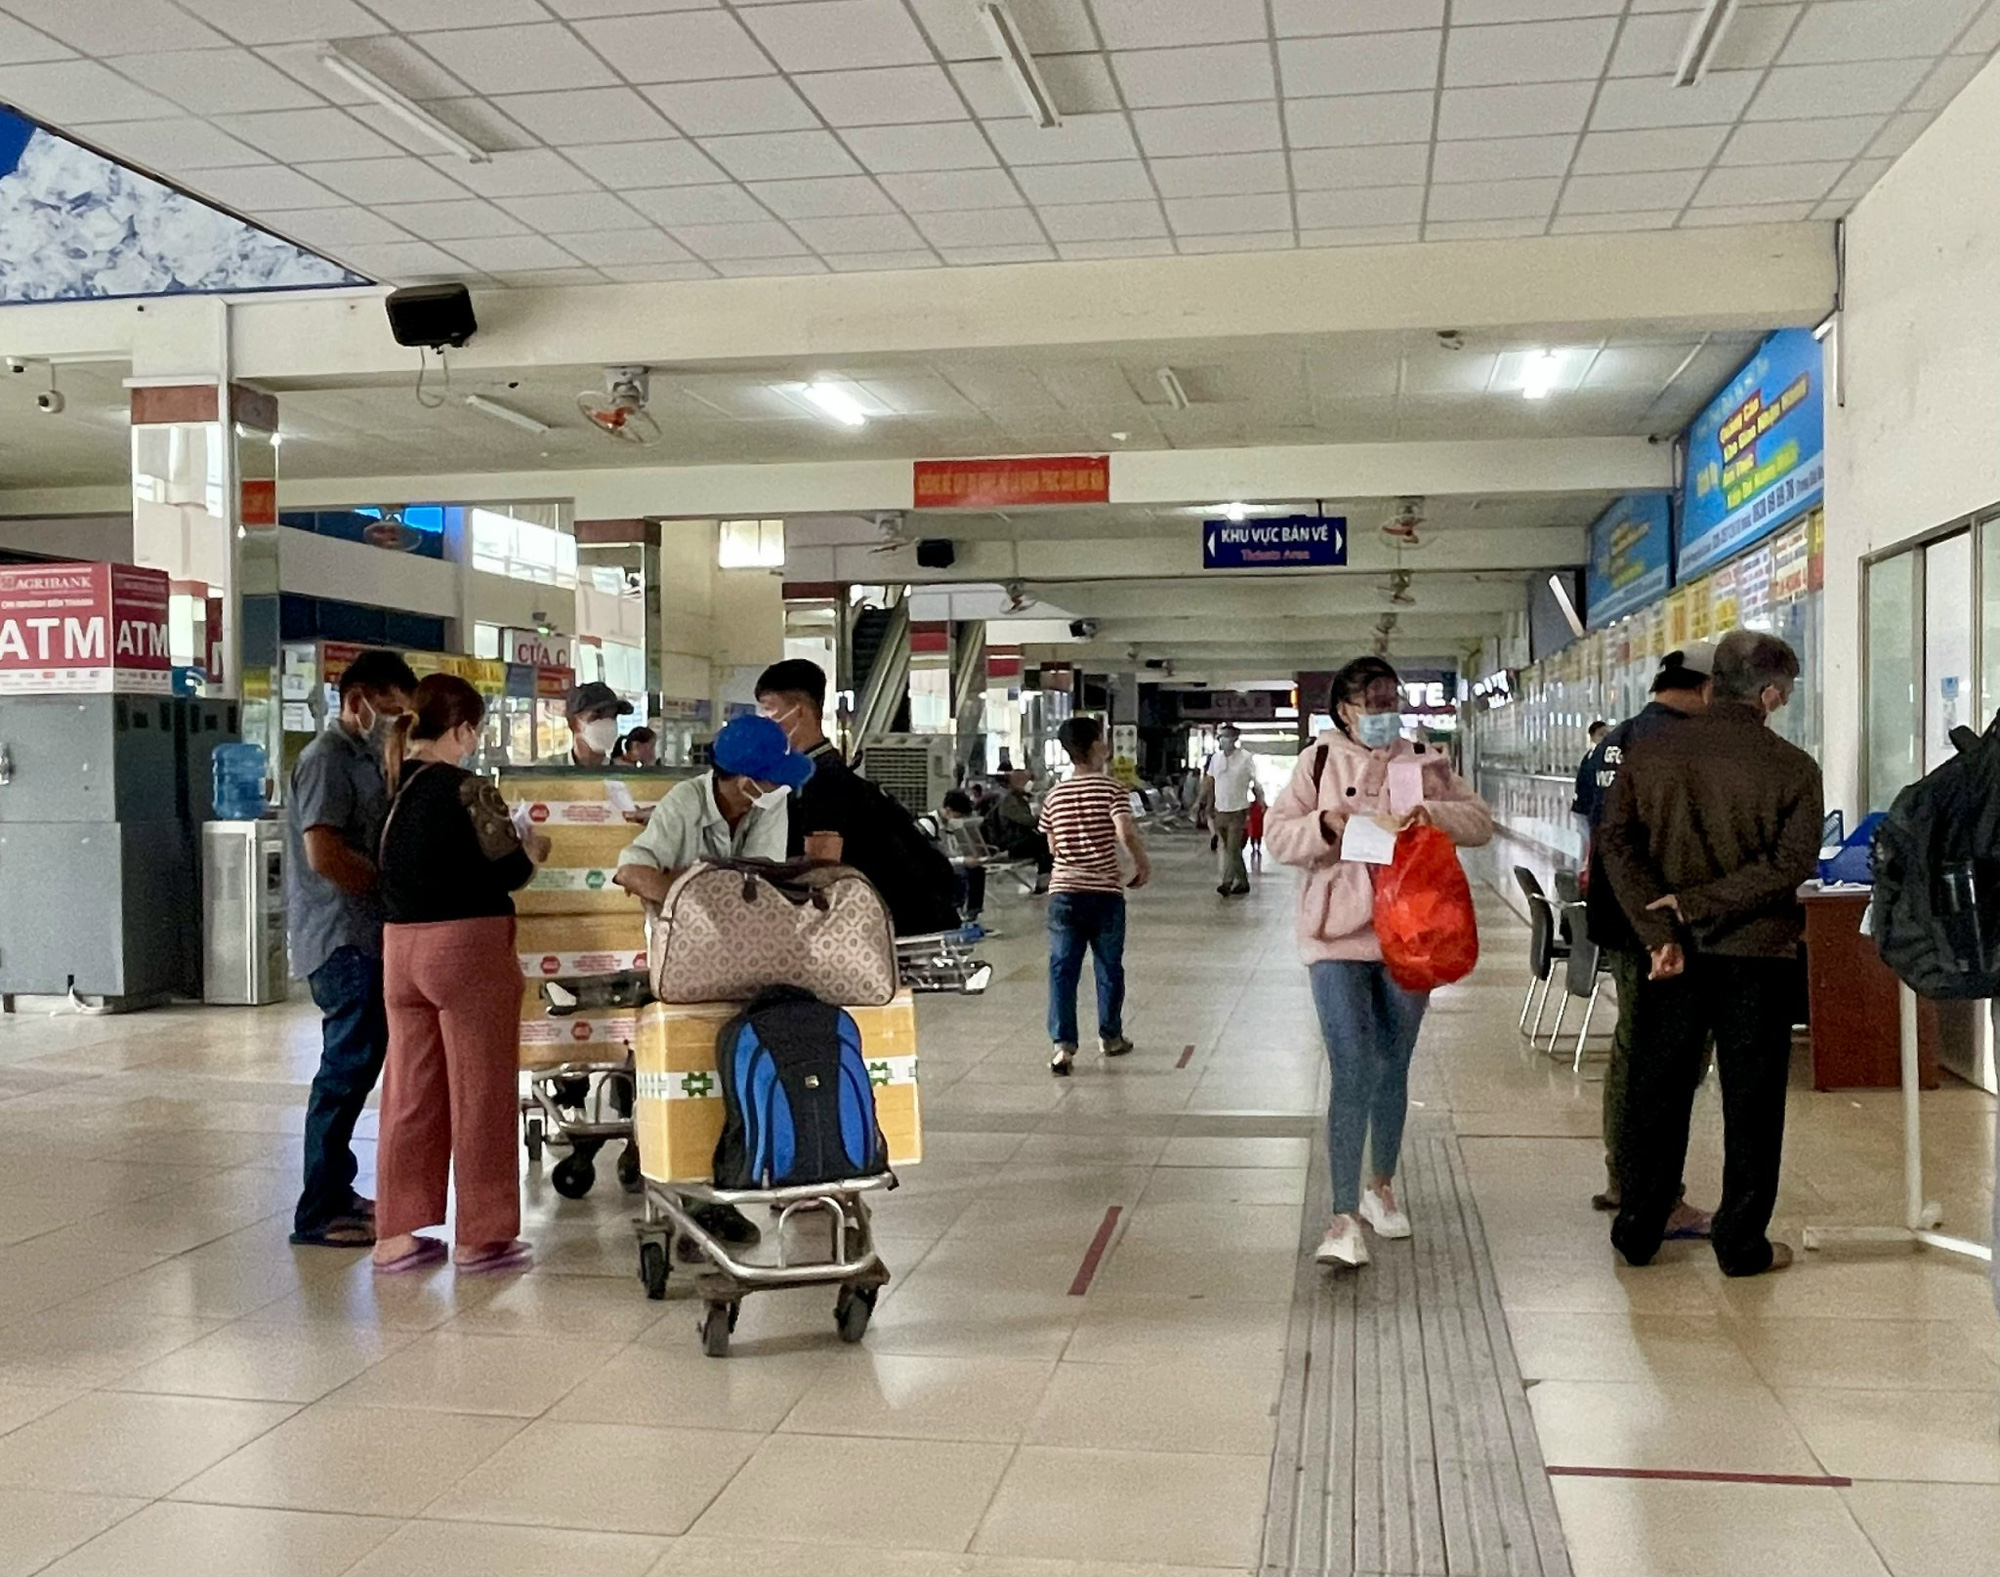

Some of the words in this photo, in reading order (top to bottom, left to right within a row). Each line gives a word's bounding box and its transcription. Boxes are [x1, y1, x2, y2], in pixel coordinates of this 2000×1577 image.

[1221, 528, 1249, 543] KHU
[1251, 527, 1280, 545] VỰC
[1281, 524, 1310, 542] BÁN
[15, 576, 93, 589] AGRIBANK
[0, 616, 105, 660] ATM
[116, 619, 170, 657] ATM
